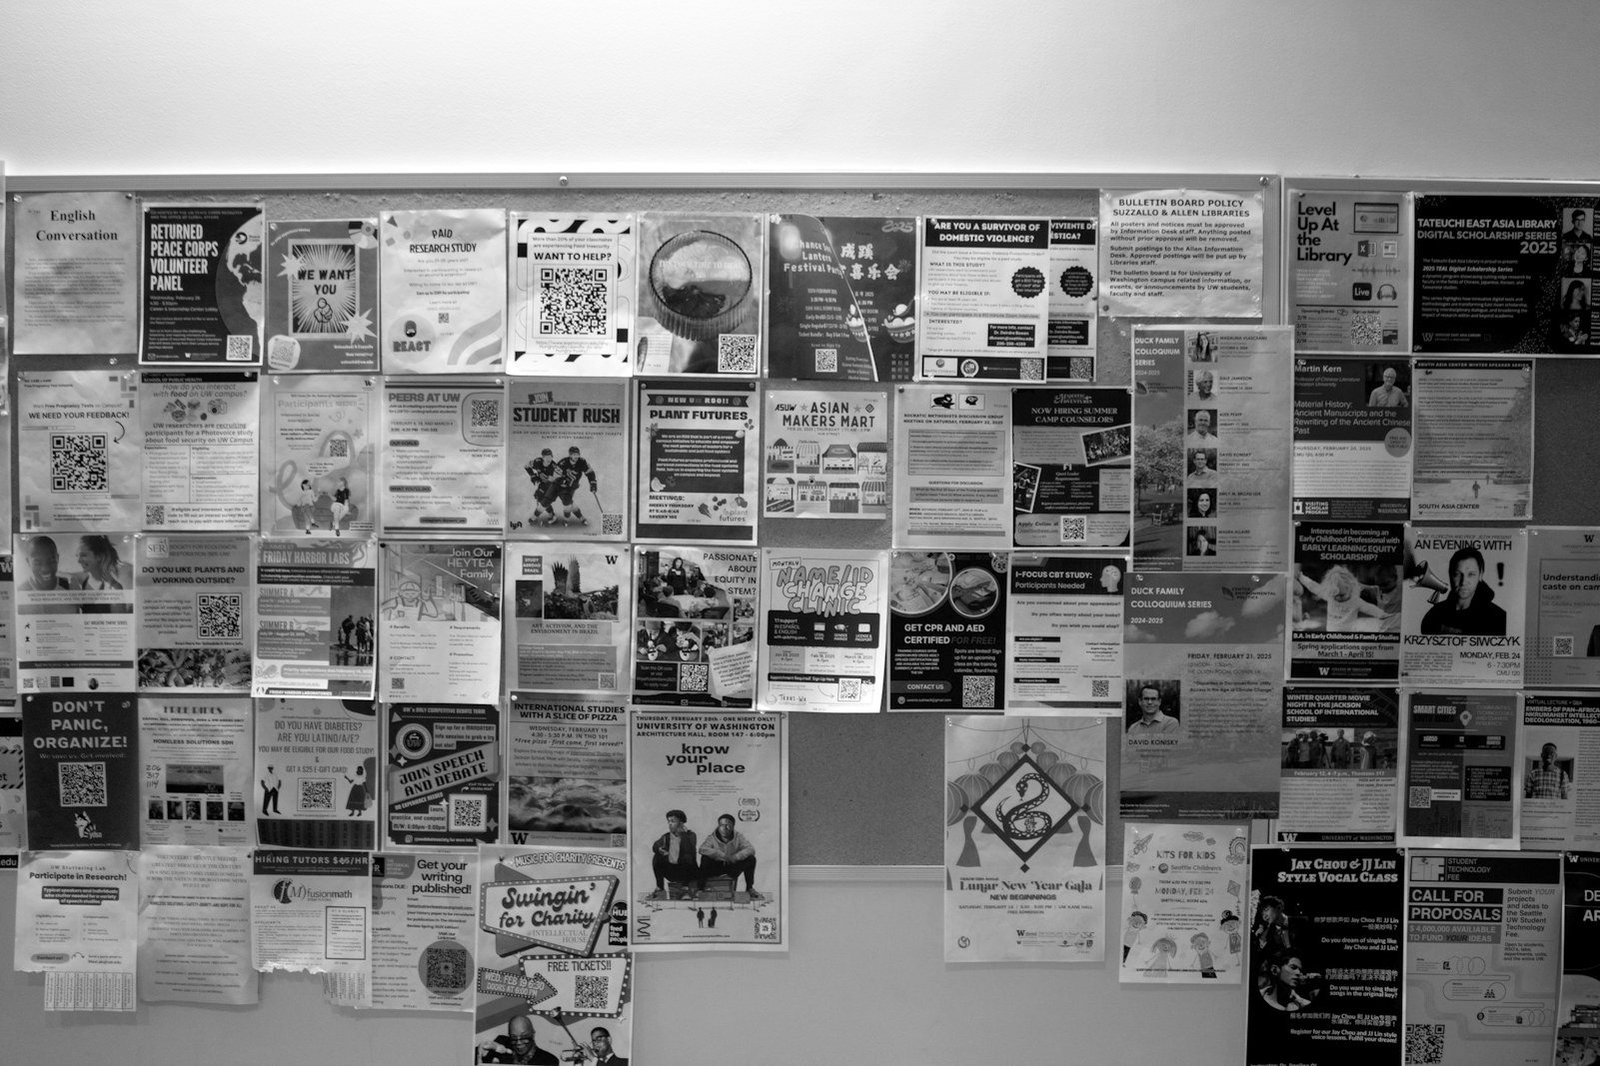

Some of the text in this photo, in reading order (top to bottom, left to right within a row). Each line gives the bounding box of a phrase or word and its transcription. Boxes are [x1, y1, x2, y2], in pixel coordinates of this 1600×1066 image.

[1298, 202, 1336, 215] Level
[51, 210, 95, 224] English
[934, 222, 951, 230] ARE
[982, 223, 1026, 231] SURVIVOR
[1298, 218, 1339, 234] Up At
[1418, 219, 1557, 228] TATEUCHI EAST ASIA LIBRARY
[36, 230, 117, 242] Conversation
[151, 224, 203, 240] RETURNED
[432, 229, 452, 238] PAID
[1418, 231, 1557, 240] DIGITAL SCHOLARSHIP SERIES
[940, 234, 1034, 243] DOMESTIC VIOLENCE?
[1297, 232, 1321, 246] the
[151, 242, 218, 257] PEACE CORPS
[410, 243, 476, 253] RESEARCH STUDY
[1520, 242, 1557, 253] 2025
[583, 253, 611, 261] HELP?
[1297, 248, 1352, 265] Library
[151, 259, 208, 274] VOLUNTEER
[784, 263, 825, 272] Festival
[298, 270, 352, 280] WE WANT
[151, 276, 183, 291] PANEL
[314, 285, 336, 295] YOU
[811, 402, 849, 414] ASIAN
[513, 408, 620, 423] STUDENT RUSH
[650, 411, 748, 420] PLANT FUTURES
[783, 415, 875, 427] MAKERS MART
[1415, 540, 1511, 550] AN EVENING WITH
[450, 548, 494, 557] Join Our
[704, 554, 757, 562] PASSIONATE
[448, 559, 494, 568] HEYTEA
[605, 556, 618, 564] W
[728, 565, 757, 573] ABOUT
[460, 569, 493, 581] Family
[777, 565, 874, 587] NAME/ID
[728, 587, 756, 595] STEM?
[782, 581, 867, 603] CHANGE
[788, 597, 861, 618] CLINIC
[905, 624, 922, 632] GET
[925, 624, 942, 632] CPR
[944, 624, 964, 632] AND
[905, 636, 949, 644] CERTIFIED
[1404, 636, 1520, 646] KRZYSZTOF SIWCZYK
[1460, 652, 1494, 660] MONDAY,
[53, 701, 104, 712] DON'T
[51, 719, 108, 732] PANIC,
[34, 736, 127, 749] ORGANIZE!
[682, 743, 729, 754] know
[666, 755, 707, 766] your
[400, 750, 484, 785] JOIN SPEECH
[697, 762, 745, 775] place
[404, 763, 488, 796] AND DEBATE
[417, 860, 468, 871] Get your
[30, 873, 74, 881] Participate
[86, 873, 127, 882] Research!
[422, 872, 463, 884] writing
[412, 884, 471, 894] published!
[960, 880, 1093, 893] Lunar New Year Gala
[307, 889, 352, 899] fusionmath
[502, 883, 595, 912] Swingin'
[1412, 890, 1484, 902] CALL FOR
[499, 909, 596, 928] for Charity
[1411, 909, 1500, 920] PROPOSALS
[548, 961, 611, 971] FREE TICKETS!!
